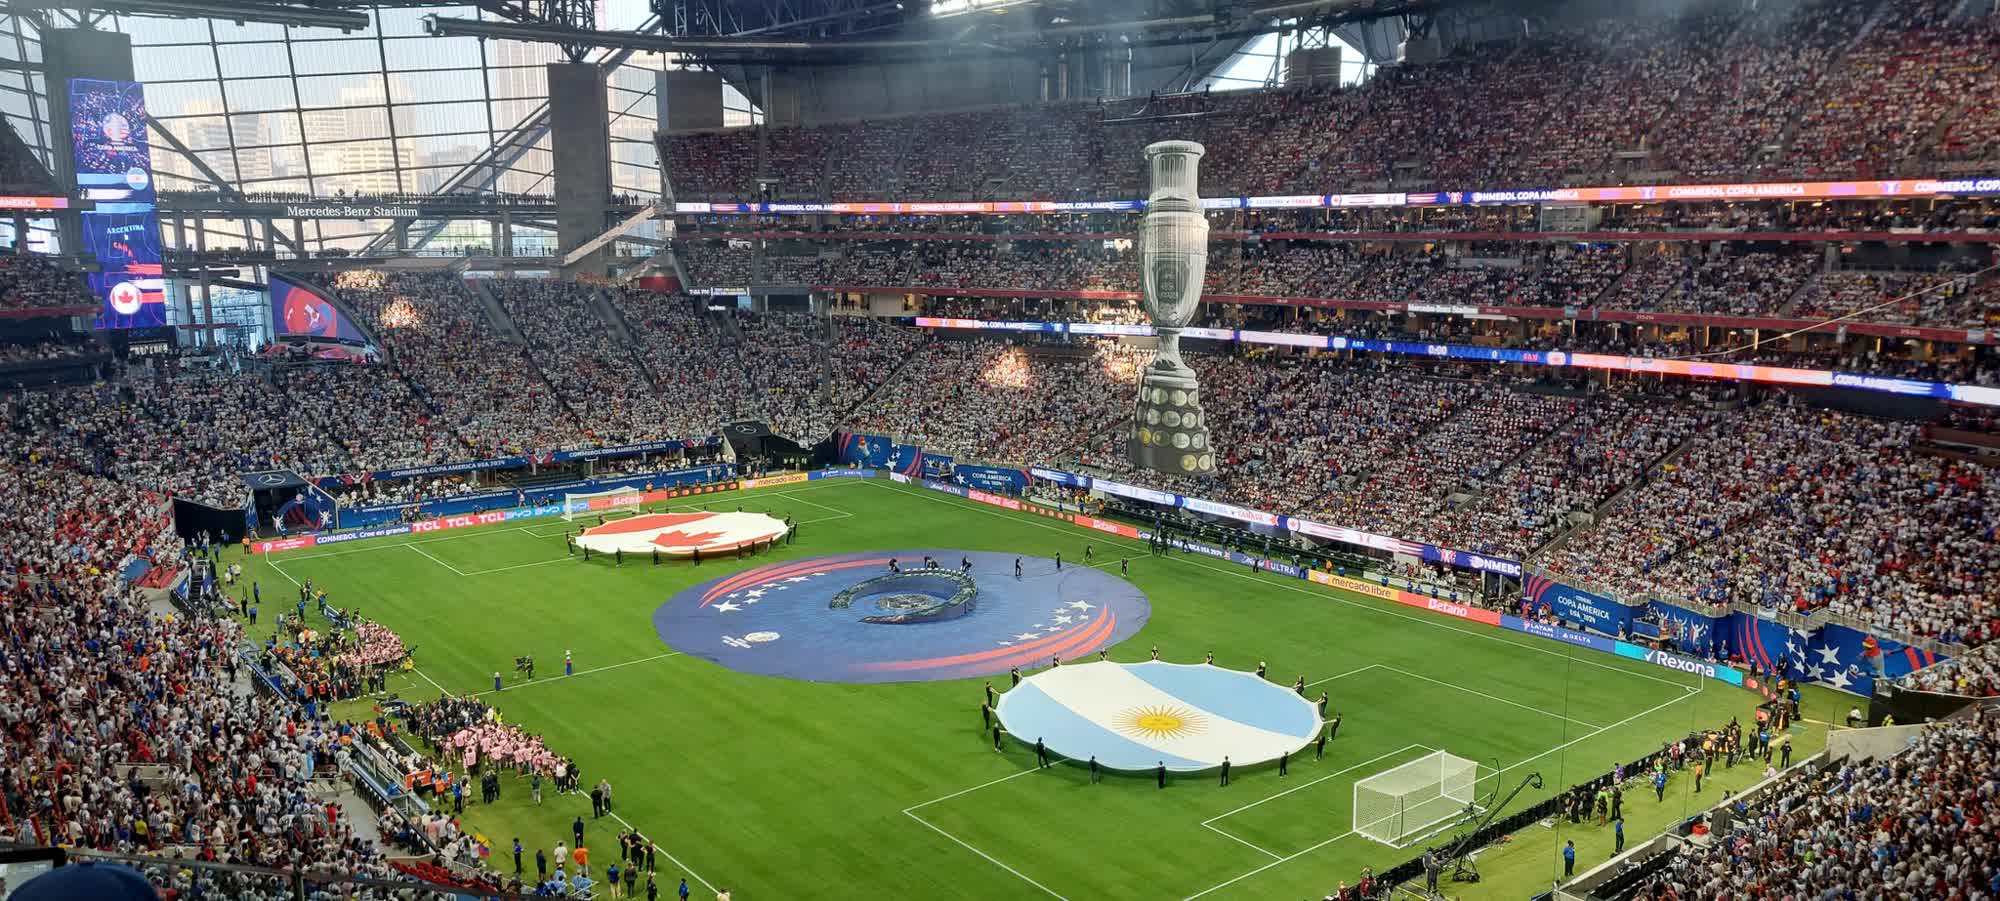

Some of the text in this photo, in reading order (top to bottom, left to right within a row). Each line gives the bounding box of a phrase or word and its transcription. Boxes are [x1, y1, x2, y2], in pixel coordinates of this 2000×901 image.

[1517, 192, 1540, 201] COPA
[1669, 185, 1805, 197] CONMEBOL COPA AMERICA
[287, 206, 418, 217] Mercedes-Benz Stadium
[106, 224, 145, 235] ARGENTINA
[391, 468, 429, 477] CONMEBOL
[429, 466, 447, 474] COPA
[448, 463, 477, 472] AMERICA
[758, 475, 803, 487] mercado libre
[987, 474, 1012, 483] AMERICA
[947, 484, 961, 495] ULTRA
[413, 512, 505, 532] TCL TCL TCL
[317, 533, 357, 545] CONMEBOL
[386, 526, 409, 537] grande
[1270, 562, 1295, 575] ULTRA
[1332, 577, 1391, 598] mercado libre
[1428, 598, 1468, 617] Betano
[1558, 595, 1610, 621] COPA AMERICA
[1569, 609, 1581, 619] USA
[1531, 621, 1554, 633] LATAM
[1569, 634, 1591, 644] DELTA
[1657, 650, 1715, 678] Rexona
